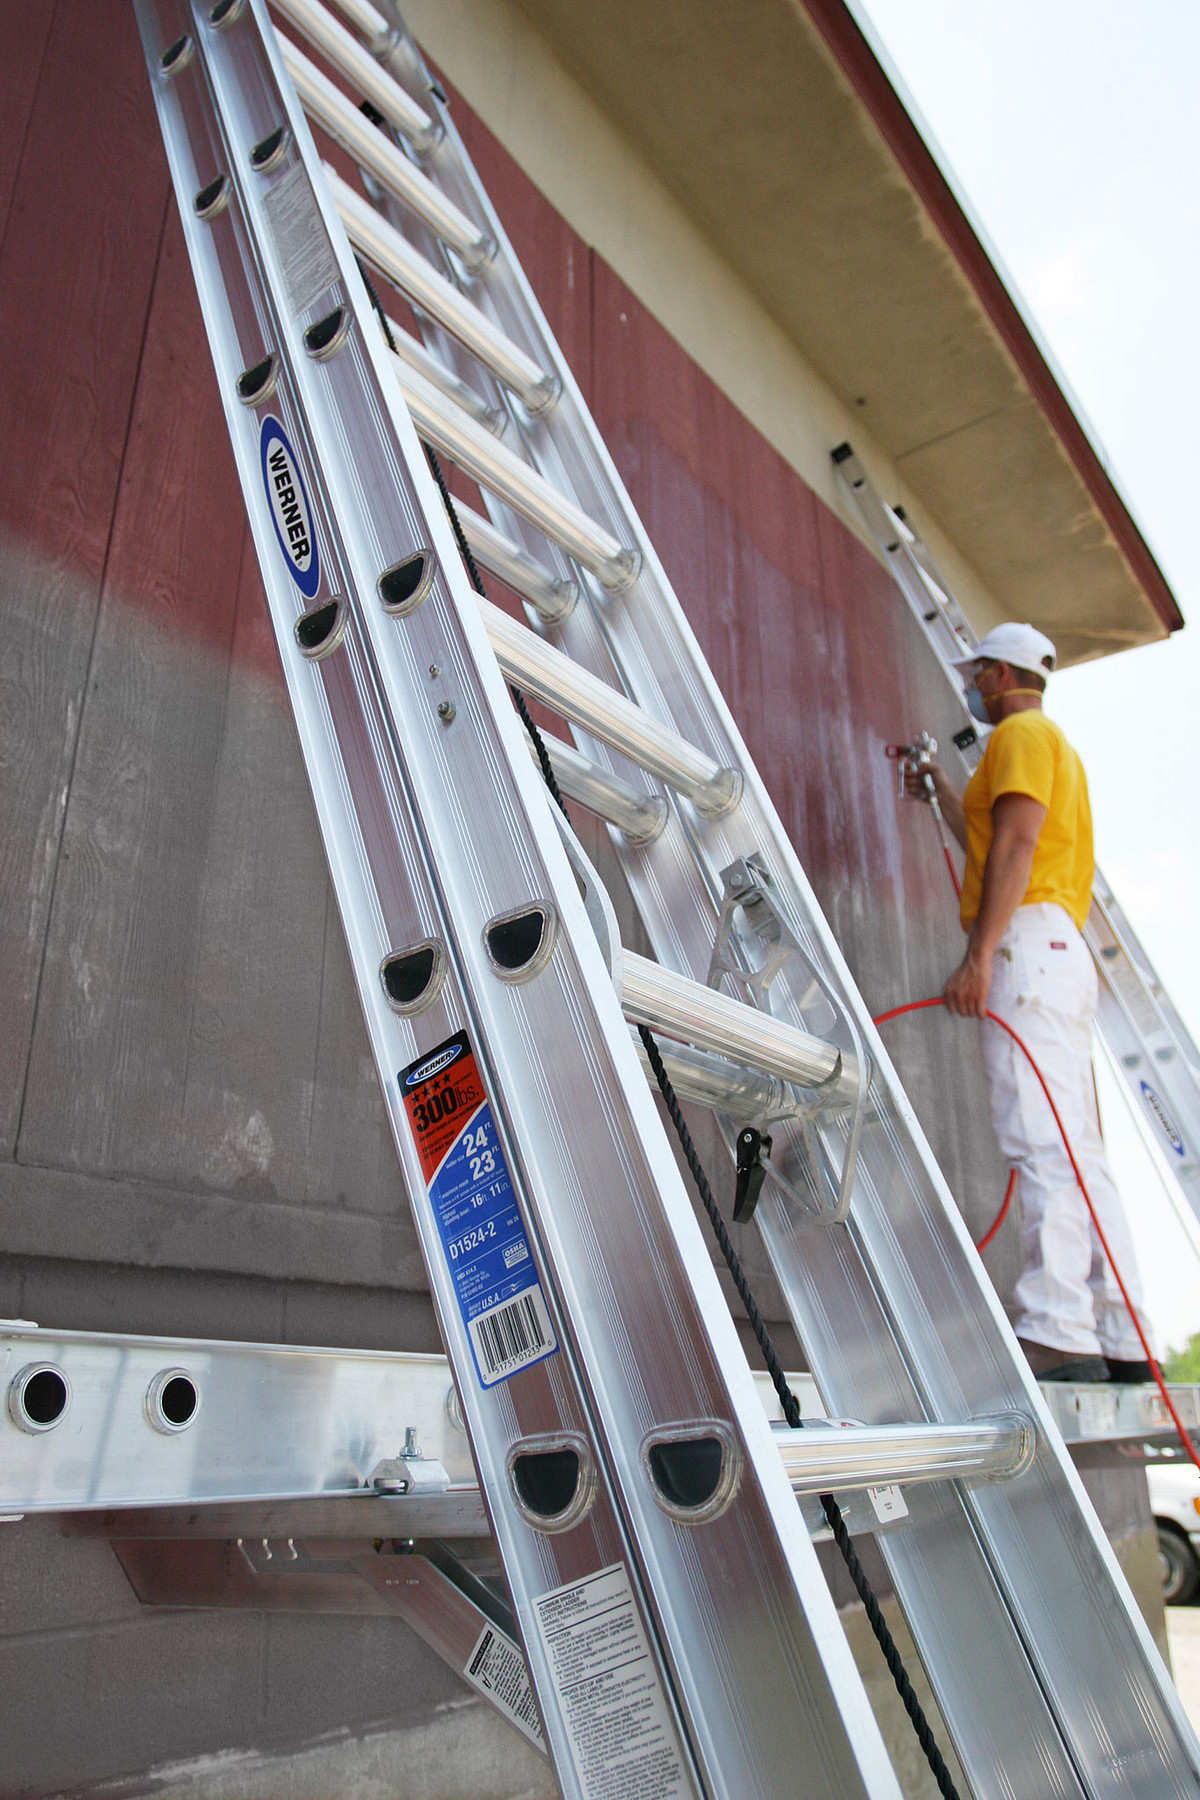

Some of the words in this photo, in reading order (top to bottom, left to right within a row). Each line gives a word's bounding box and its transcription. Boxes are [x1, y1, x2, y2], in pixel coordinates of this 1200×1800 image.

[269, 447, 310, 561] WERNER
[417, 1052, 452, 1078] WERNER
[463, 1126, 488, 1157] 24
[470, 1150, 495, 1180] 23
[450, 1222, 496, 1260] D1524-2
[504, 1243, 524, 1257] OSHA
[495, 1357, 517, 1374] 51751
[519, 1345, 541, 1362] 01233
